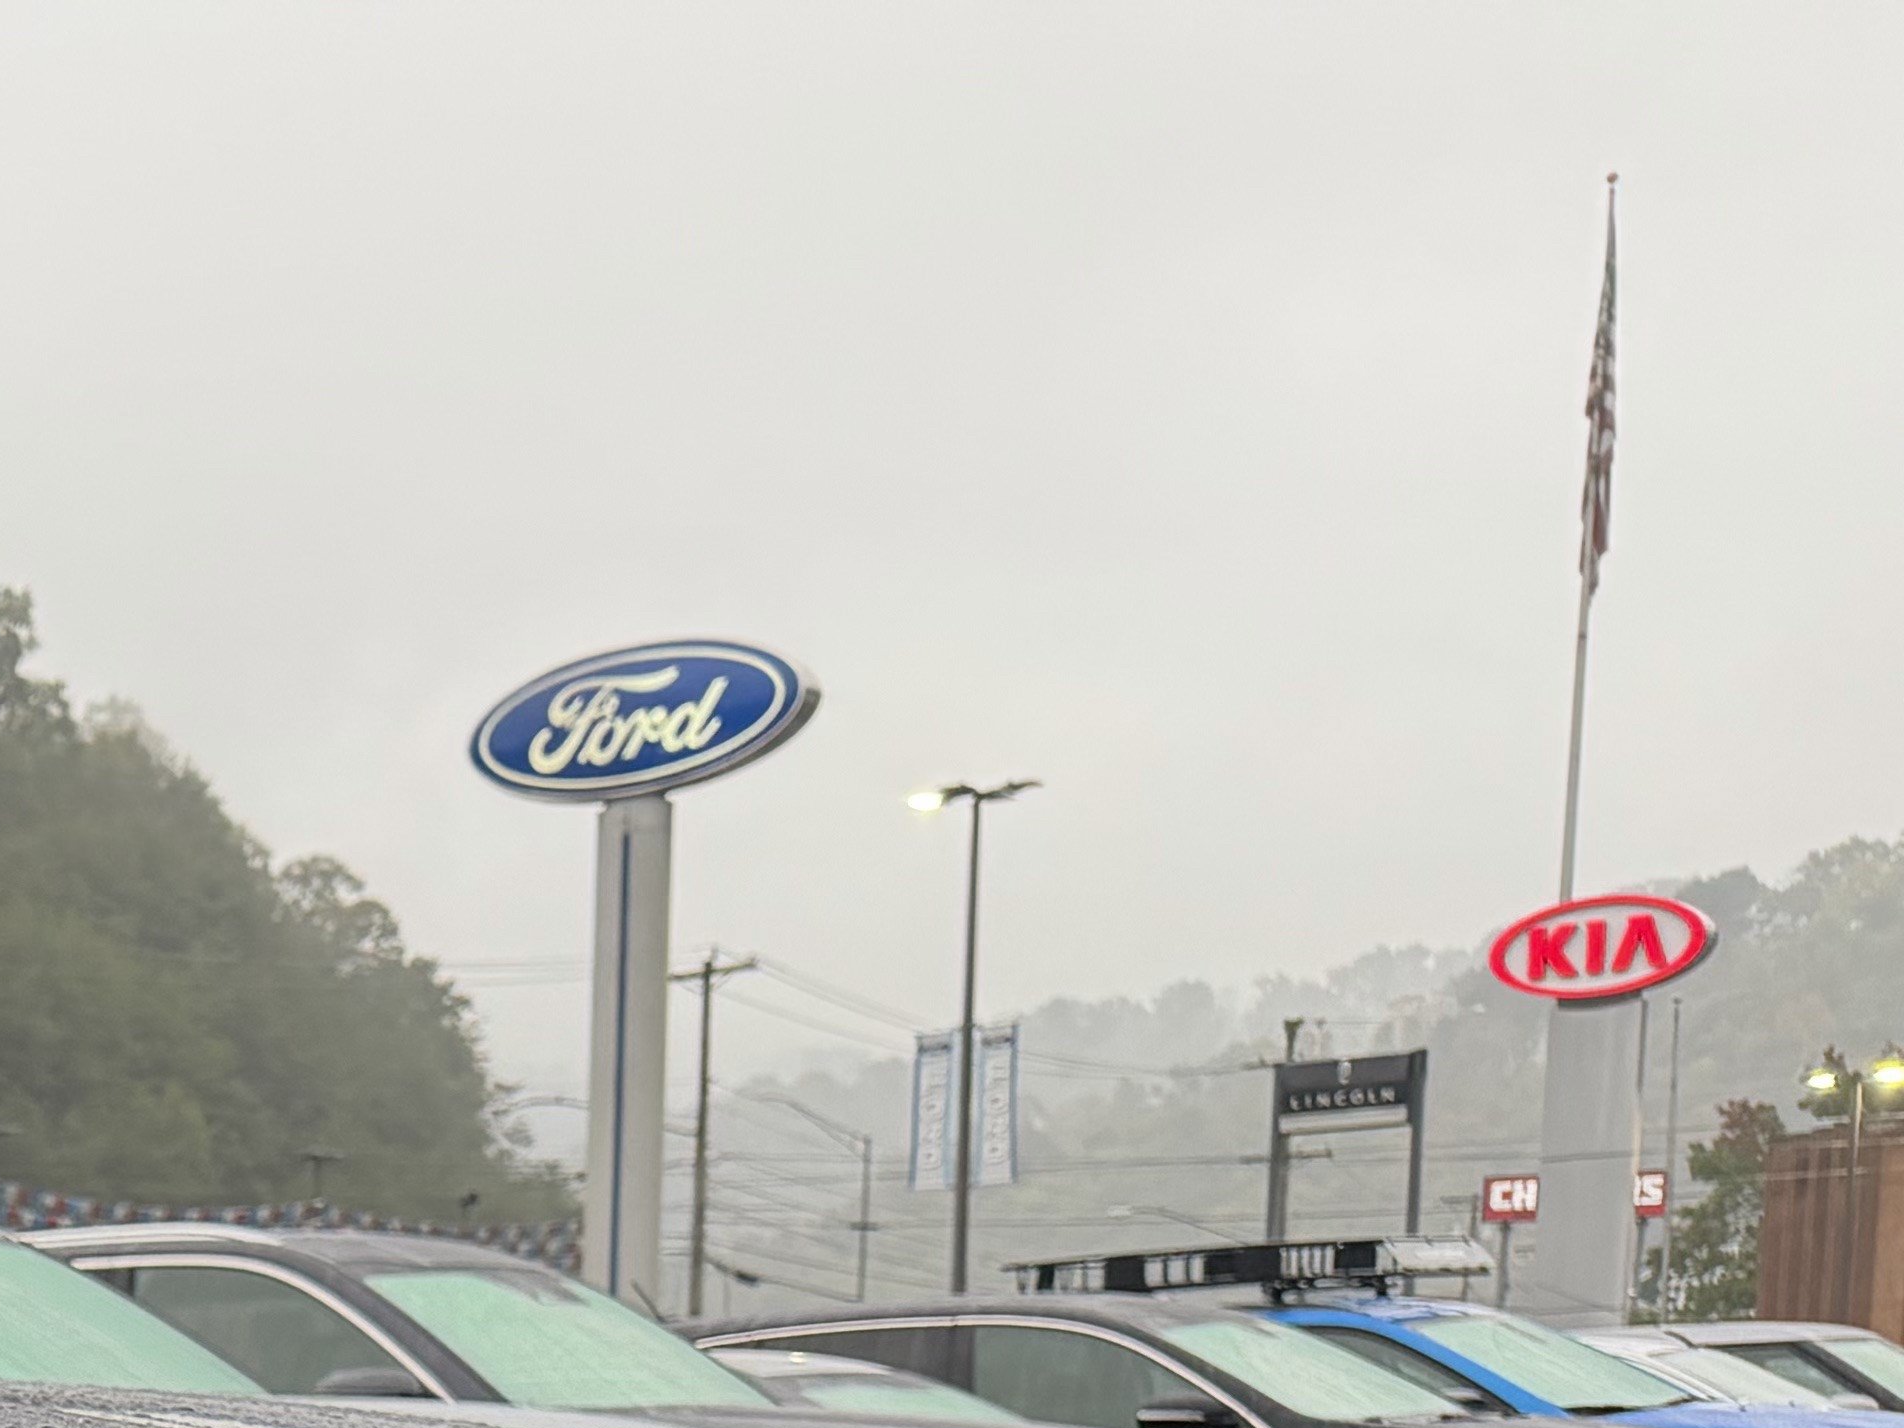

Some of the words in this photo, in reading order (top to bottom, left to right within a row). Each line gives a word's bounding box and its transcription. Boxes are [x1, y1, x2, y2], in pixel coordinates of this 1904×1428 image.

[528, 665, 729, 775] Ford
[1527, 912, 1667, 981] KIA
[1290, 1087, 1396, 1111] LINCOLN
